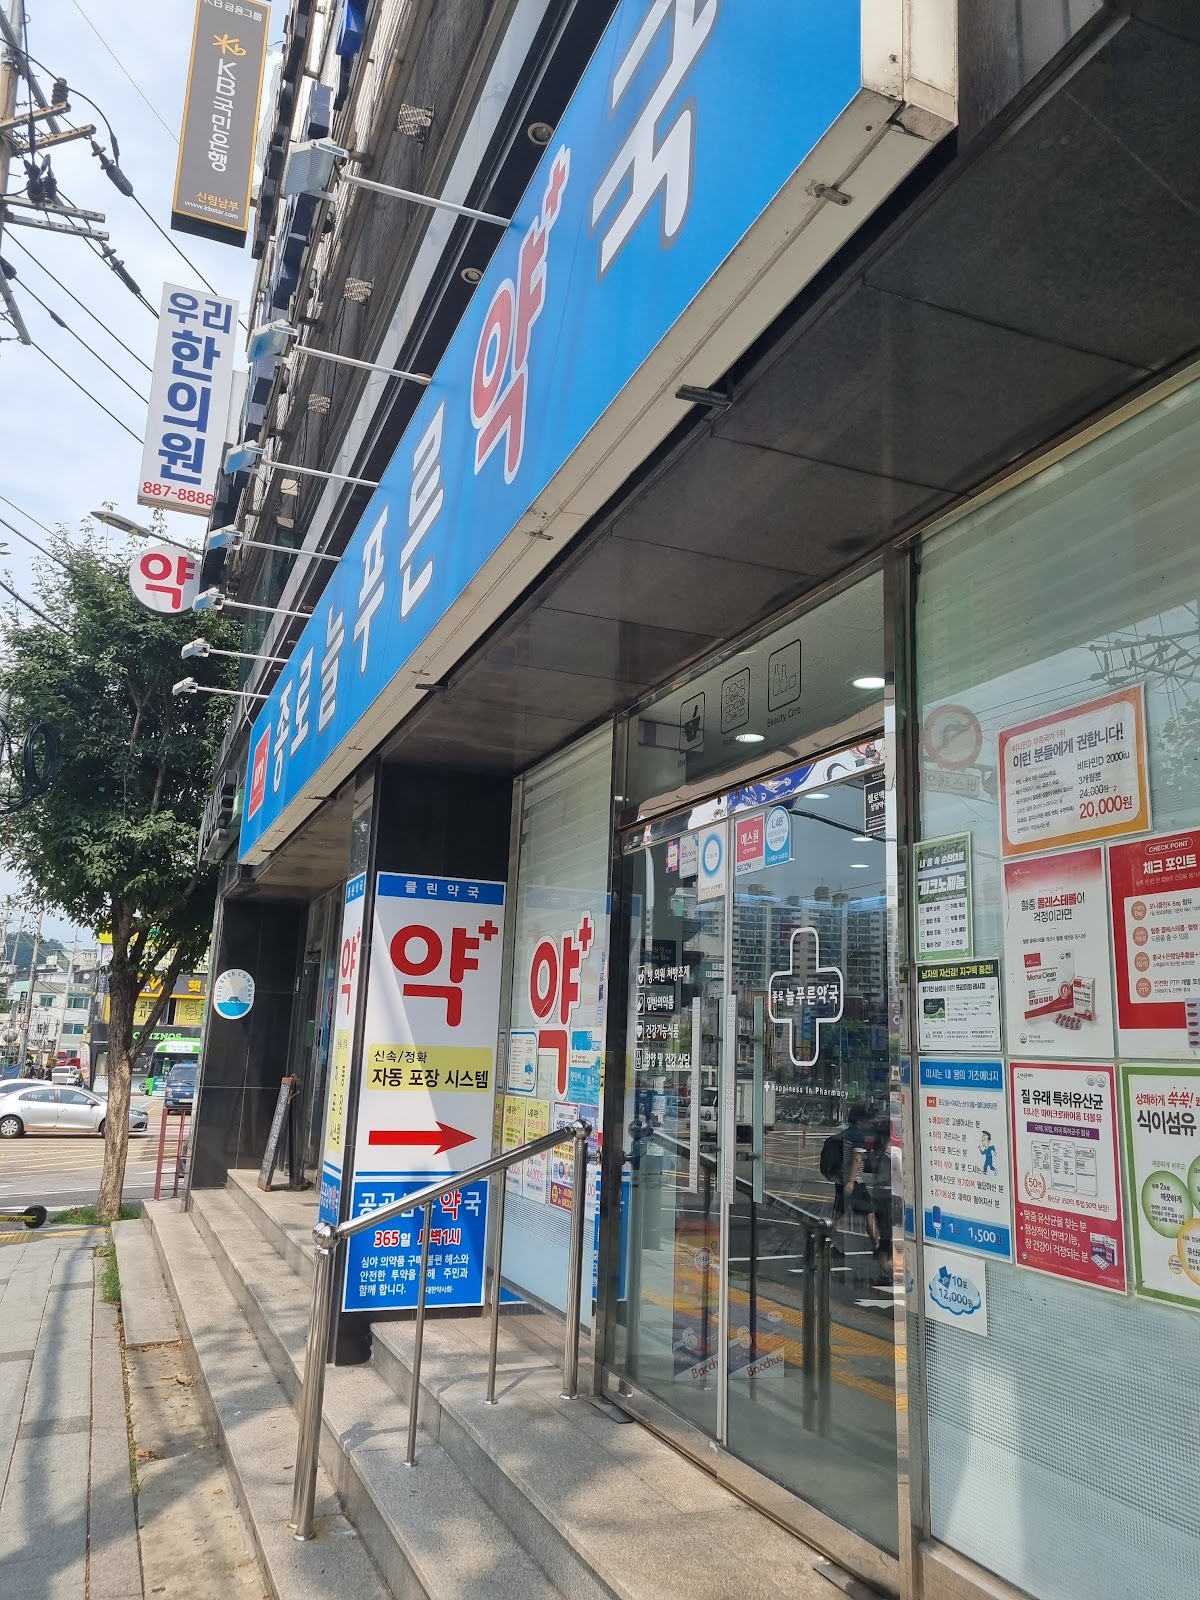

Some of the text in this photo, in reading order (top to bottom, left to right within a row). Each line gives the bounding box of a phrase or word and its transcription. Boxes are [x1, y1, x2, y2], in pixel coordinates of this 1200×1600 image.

[208, 59, 237, 172] KB국민은행
[184, 200, 239, 220] www.kbstar.com
[196, 191, 239, 211] 신림남부
[158, 292, 232, 485] 우리 한의원
[142, 481, 214, 506] 887-8888
[140, 553, 195, 609] 약
[767, 706, 801, 728] Beauty Care
[1012, 721, 1123, 770] 이런 분들에게 권합니다!
[1076, 748, 1129, 772] 비타민D 2000iu
[1078, 770, 1101, 785] 3개월분
[1078, 792, 1132, 820] 20,000원
[741, 829, 759, 846] 에스원
[1148, 839, 1188, 854] CHECK POINT
[1142, 851, 1197, 876] 체크 포인트
[1020, 891, 1085, 911] 혈중 콜레스테롤이
[1033, 907, 1072, 923] 걱정이라면
[390, 924, 480, 1028] 약
[666, 965, 690, 982] 처방조제
[921, 969, 938, 979] 남자의
[939, 967, 958, 977] 자신감!
[959, 965, 977, 976] 지구력
[1169, 978, 1179, 986] PTP
[219, 971, 236, 984] BEER
[237, 971, 253, 1003] COMPANY
[646, 994, 675, 1012] 일반의약품
[530, 936, 580, 1095] 약
[645, 1023, 680, 1039] 건강기능식품
[374, 1050, 427, 1063] 신속/정확
[678, 1052, 691, 1069] 상담
[372, 1067, 489, 1089] 자동 포장 시스템
[925, 1067, 999, 1083] 마시는 내 몸의 기초에너지
[771, 1084, 849, 1100] Happiness In Pharmacy
[1020, 1088, 1104, 1111] 질 유래 특허유산균
[1135, 1090, 1193, 1108] 상쾌하게 쑥쑥!
[1023, 1107, 1102, 1123] 더나은 마이크로바이옴 더블유
[1136, 1109, 1196, 1137] 식이섬유
[358, 1189, 482, 1220] 공공약국
[1047, 1194, 1060, 1204] 유산균
[1160, 1192, 1182, 1203] 깨끗하게
[1023, 1209, 1087, 1233] 맞춤 유산균을 찾는 분
[374, 1229, 411, 1248] 365일
[1024, 1224, 1080, 1248] 정상적인 면역기능,
[360, 1256, 378, 1268] 심야
[380, 1255, 405, 1268] 의약품
[444, 1253, 469, 1266] 해소와
[1024, 1238, 1088, 1263] 장 건강이 걱정되는 분
[360, 1270, 386, 1283] 안전한
[391, 1269, 416, 1281] 투약을
[443, 1267, 468, 1279] 주민과
[359, 1283, 407, 1297] 함께 합니다.
[746, 1354, 783, 1377] Bacchus
